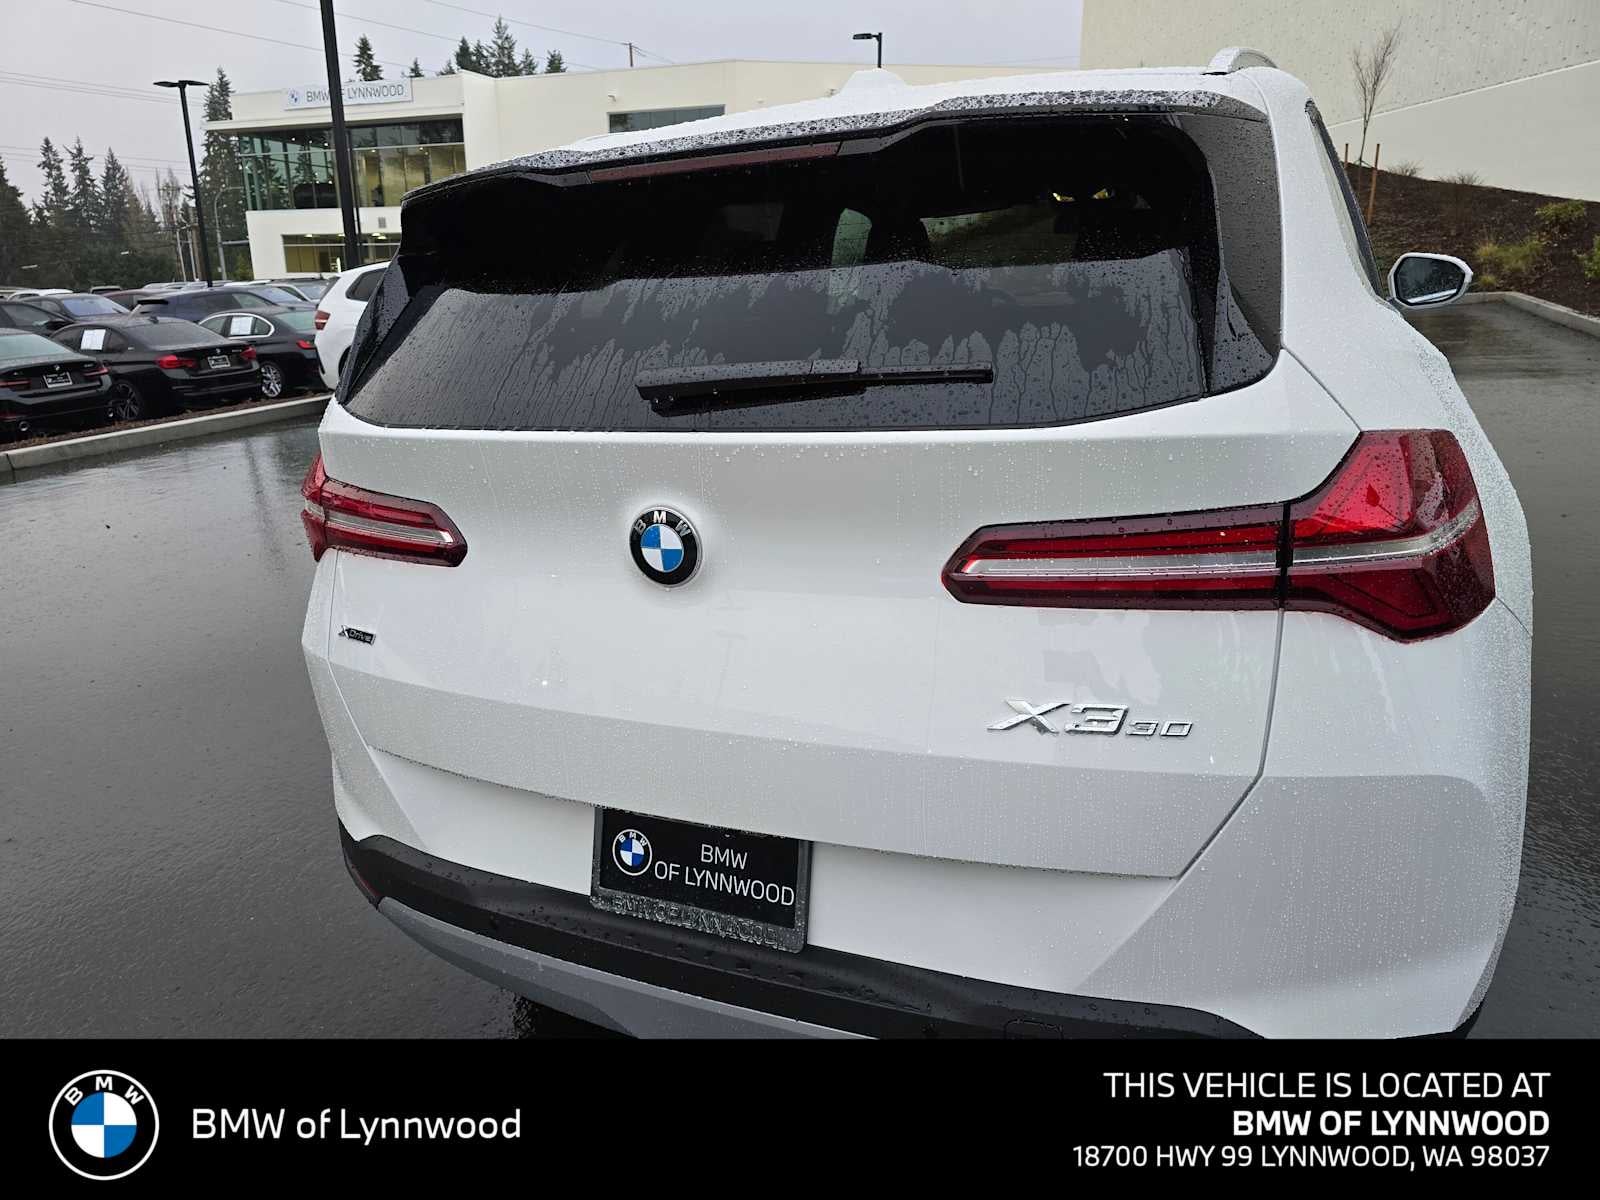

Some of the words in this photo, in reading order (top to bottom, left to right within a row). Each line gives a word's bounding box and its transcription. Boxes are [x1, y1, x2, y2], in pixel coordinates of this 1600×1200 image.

[306, 90, 330, 102] BMW
[347, 84, 404, 99] LYNNWOOD
[634, 510, 692, 537] BMW
[987, 697, 1129, 736] X3
[1125, 720, 1192, 737] 30
[618, 831, 648, 847] BMW
[701, 843, 748, 870] BMW
[654, 860, 681, 882] OF
[685, 866, 795, 906] LYNNWOOD
